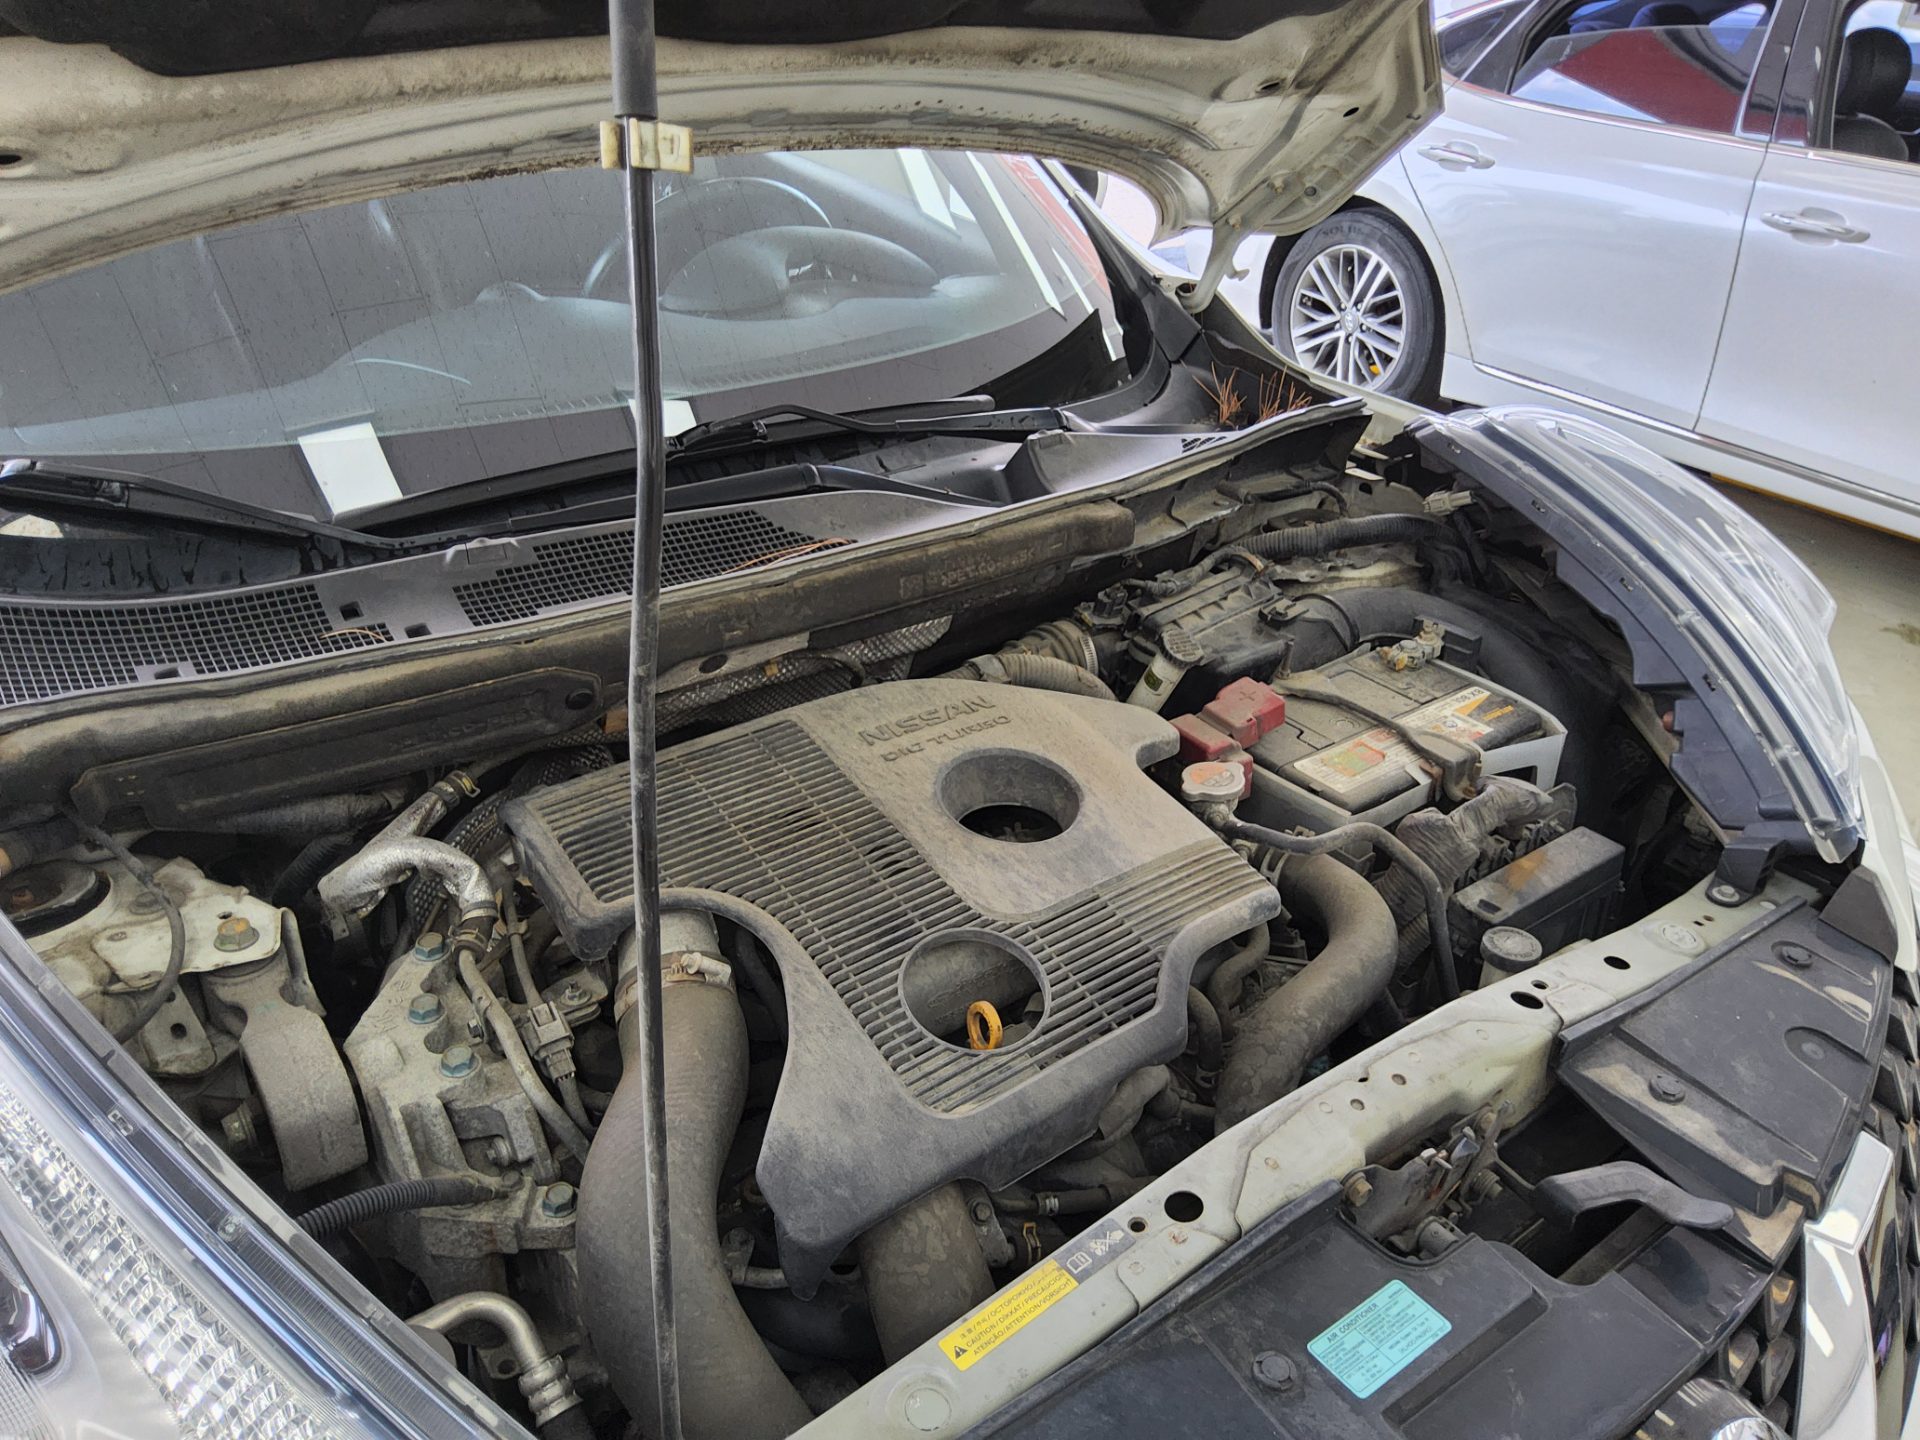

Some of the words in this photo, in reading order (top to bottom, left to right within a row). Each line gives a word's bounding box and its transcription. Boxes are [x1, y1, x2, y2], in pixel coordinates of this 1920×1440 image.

[858, 696, 996, 746] NISSAN
[880, 742, 925, 762] DIG
[927, 715, 1012, 744] TURBO
[1326, 1332, 1339, 1344] AIR
[1338, 1302, 1380, 1334] CONDITIONER
